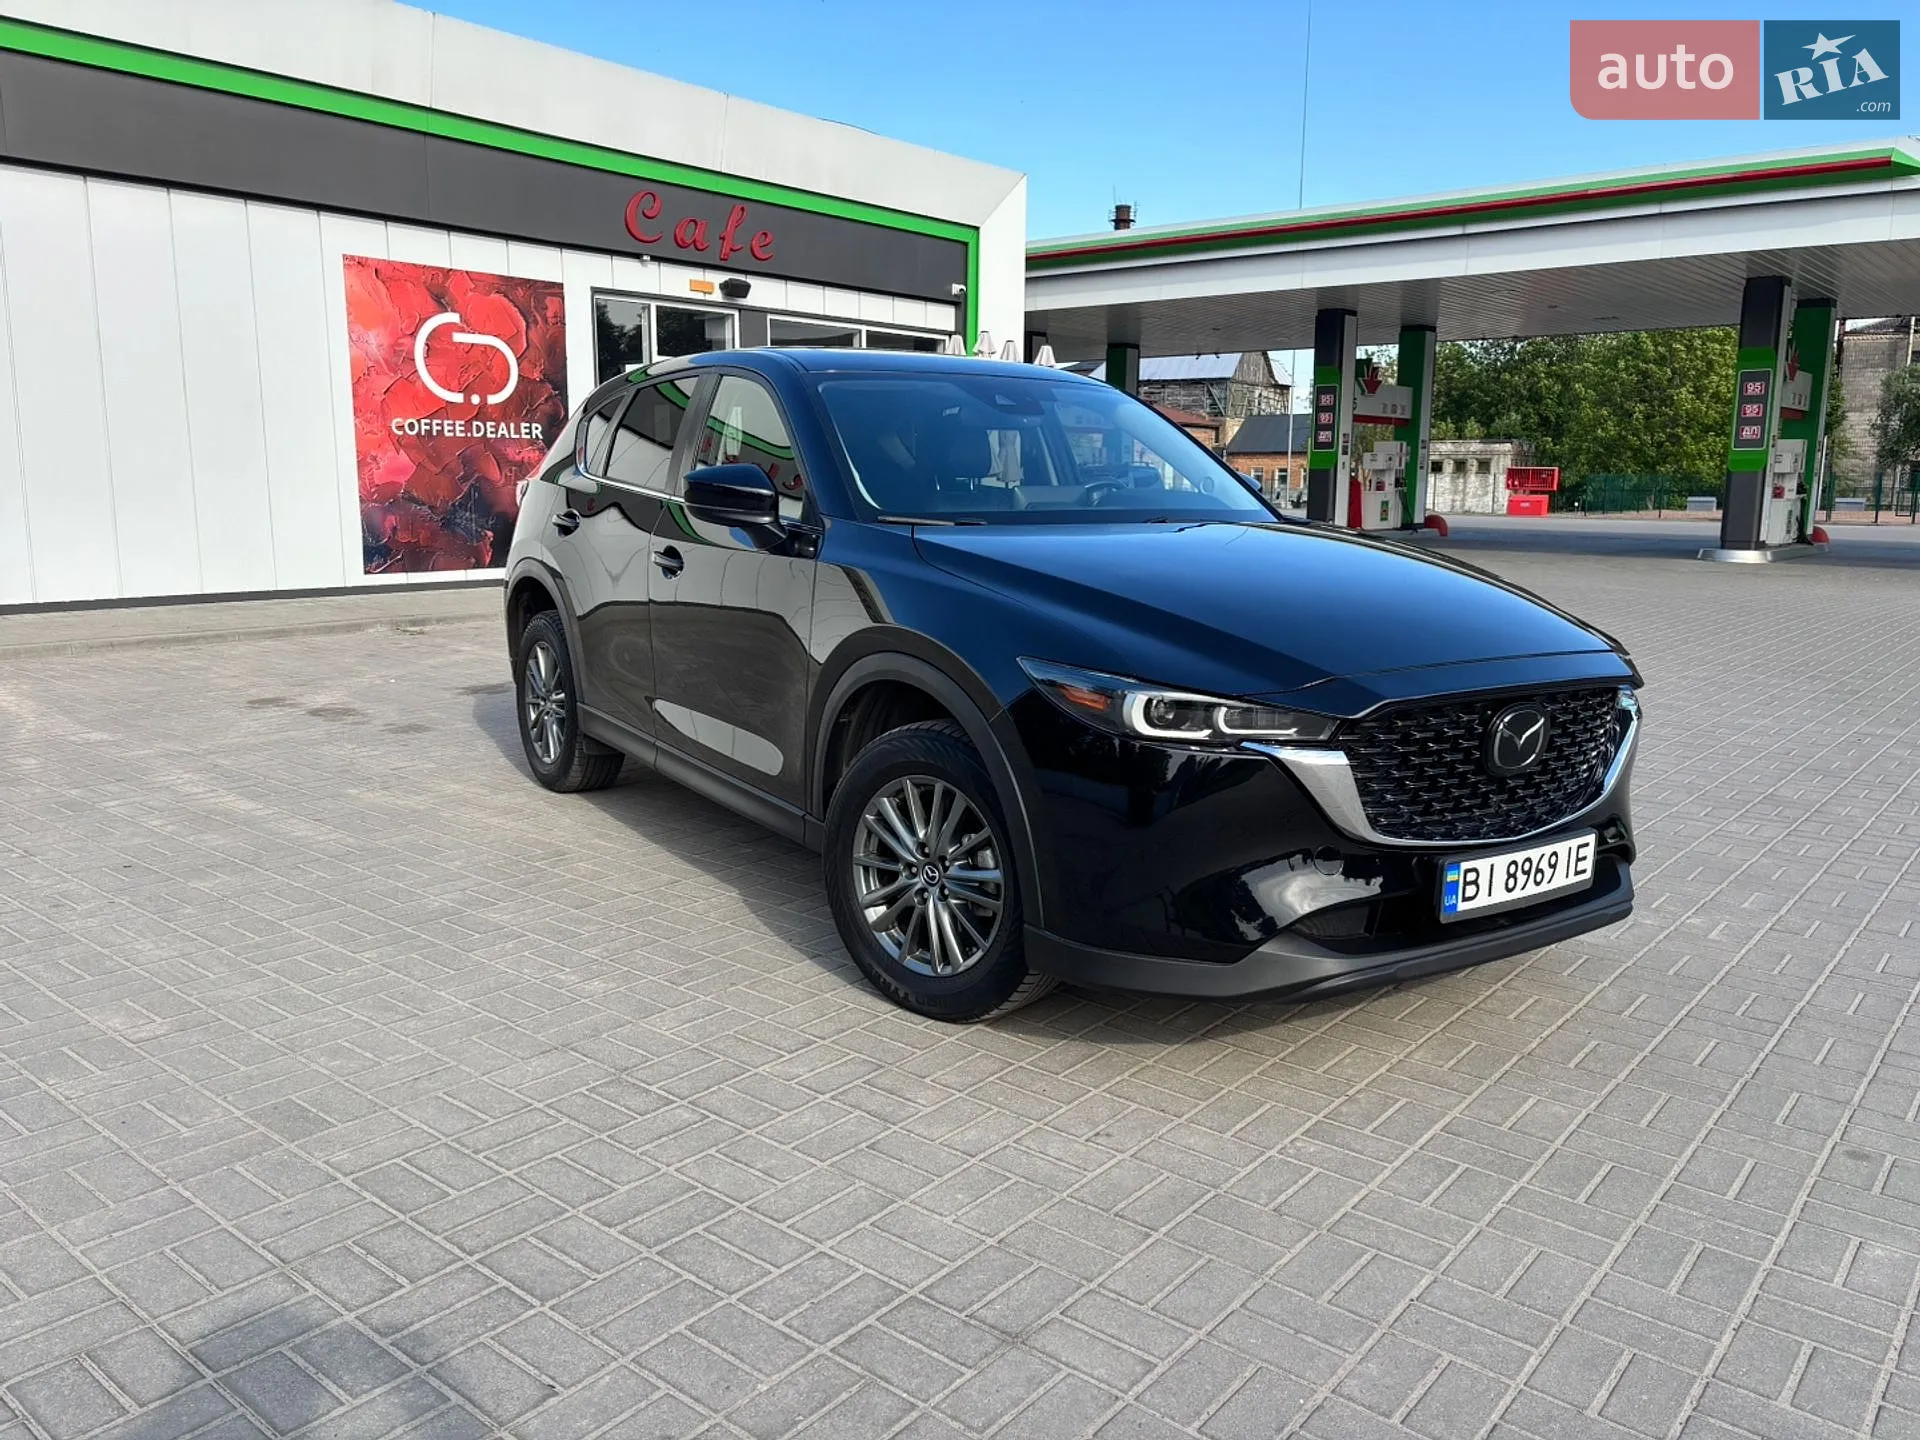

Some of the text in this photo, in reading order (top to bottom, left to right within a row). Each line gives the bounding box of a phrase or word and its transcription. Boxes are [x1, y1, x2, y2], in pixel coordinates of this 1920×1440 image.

[624, 190, 775, 262] Cafe
[391, 417, 543, 440] COFFEE.DEALER
[1505, 850, 1558, 893] 8969
[1565, 842, 1590, 879] IE
[1444, 895, 1457, 906] UA
